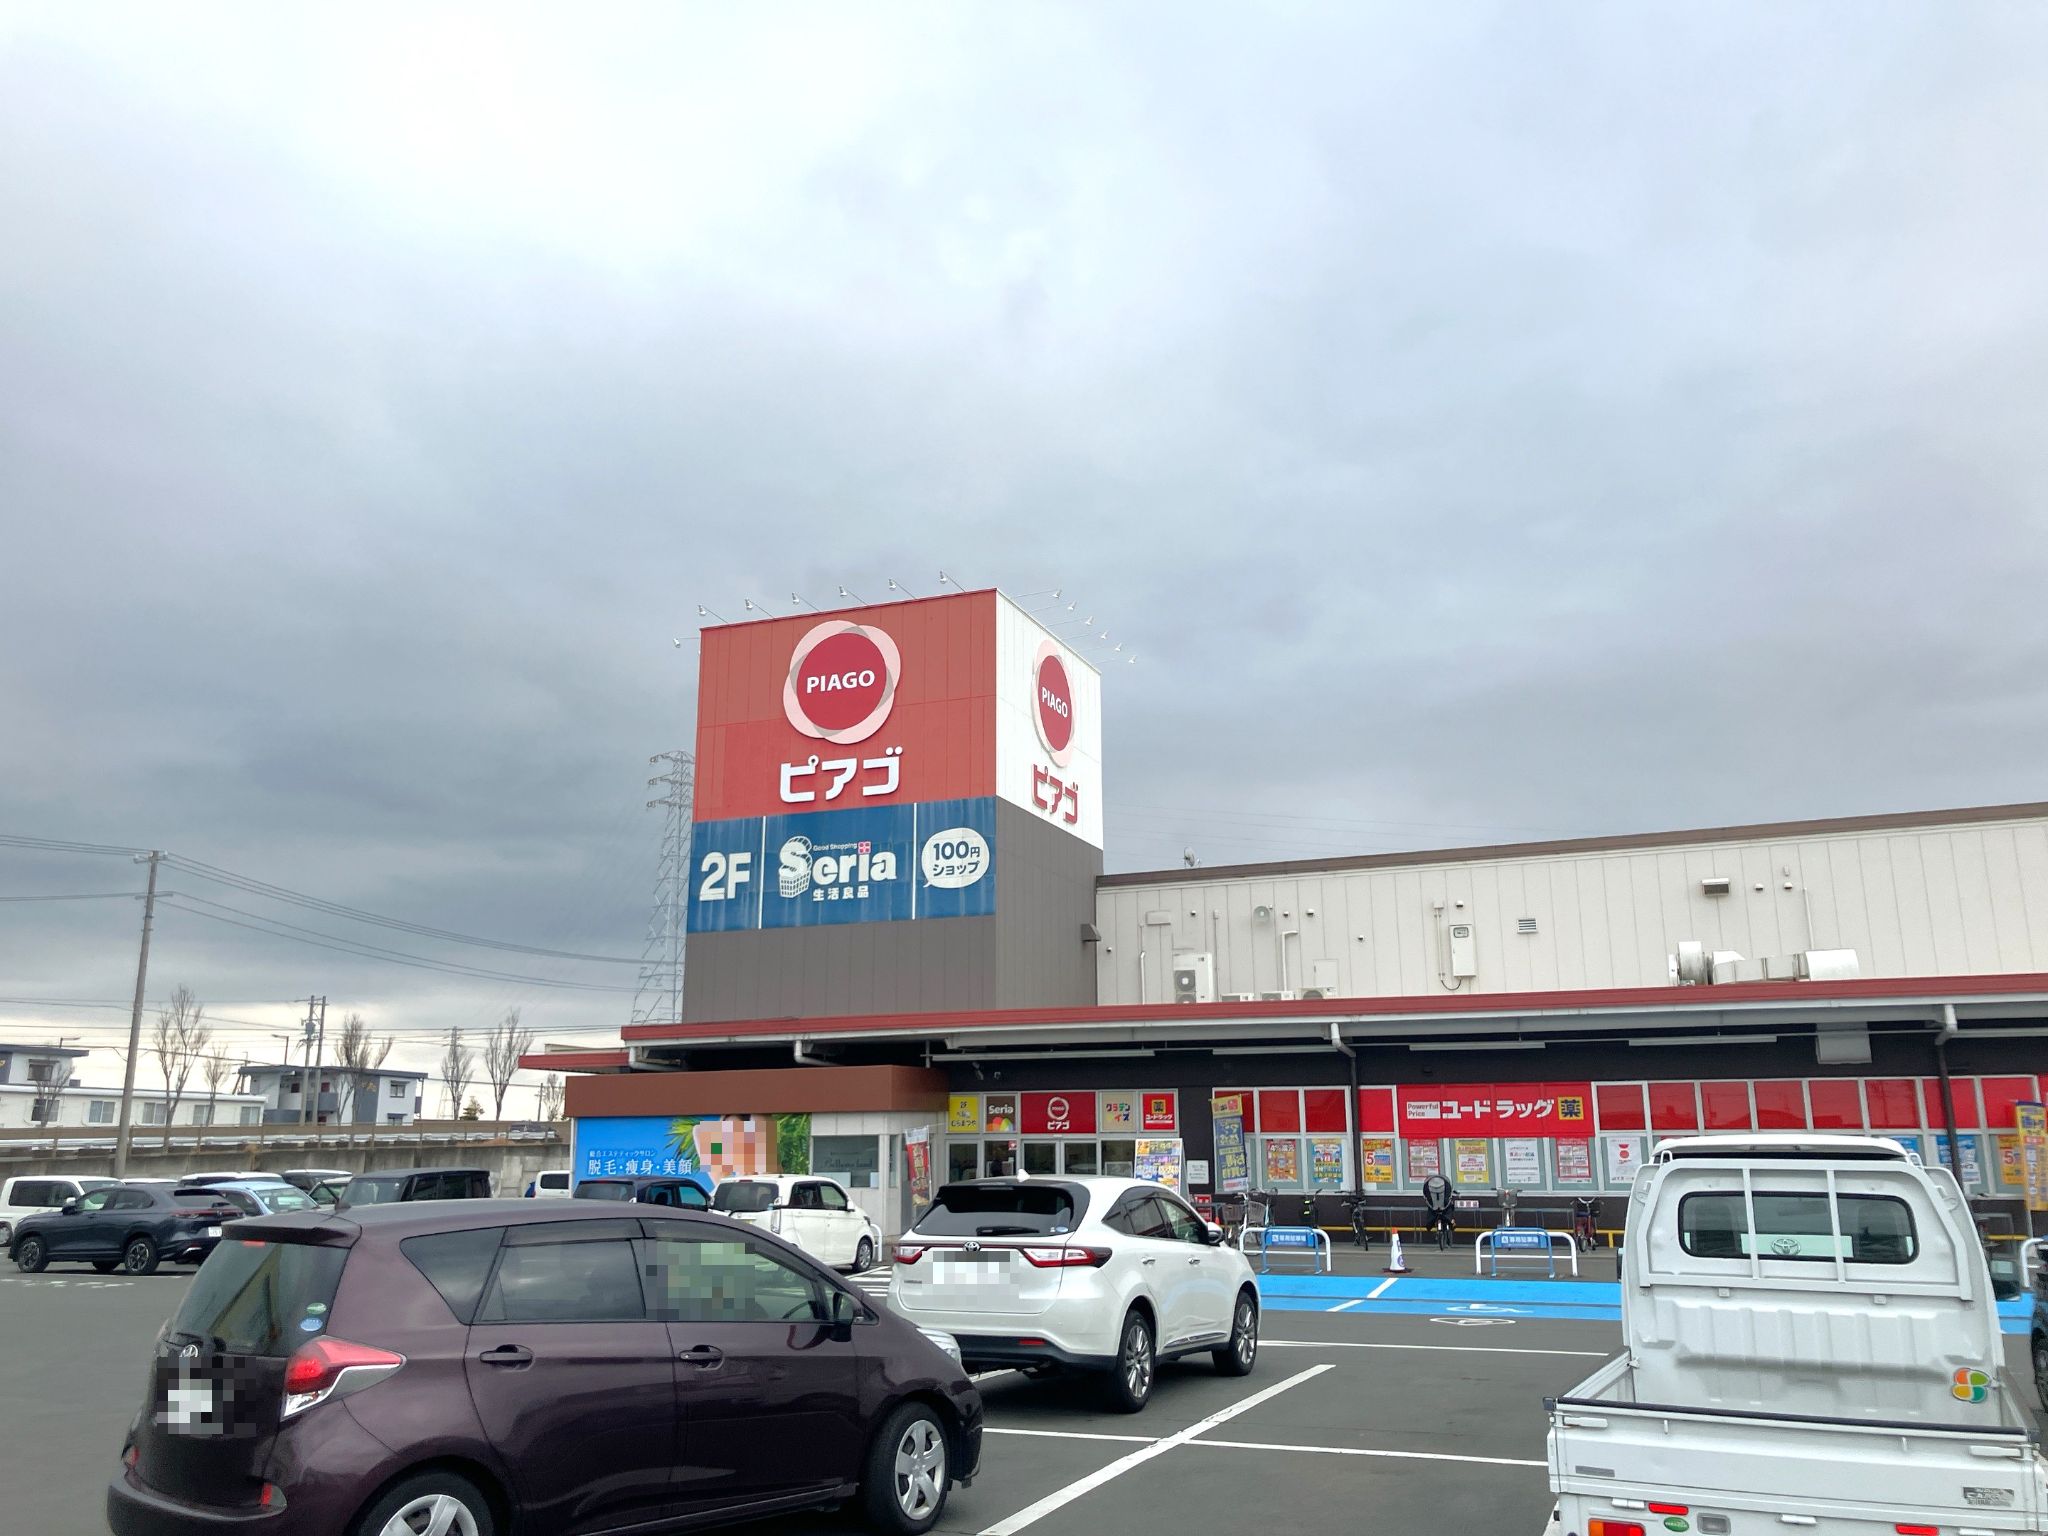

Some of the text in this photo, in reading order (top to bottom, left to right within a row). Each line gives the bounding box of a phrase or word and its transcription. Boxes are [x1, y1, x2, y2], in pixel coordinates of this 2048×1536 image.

[806, 669, 876, 694] PIAGO
[1041, 687, 1069, 718] PIAGO
[779, 746, 903, 803] ピアゴ
[1032, 763, 1079, 825] ピアゴ
[932, 840, 980, 861] 100円
[699, 851, 751, 902] 2F
[778, 835, 897, 898] Seria
[932, 860, 980, 877] ショップ
[812, 885, 869, 902] 生活良品
[988, 1104, 1014, 1114] Seria
[1442, 1099, 1581, 1119] ユードラッグ 薬
